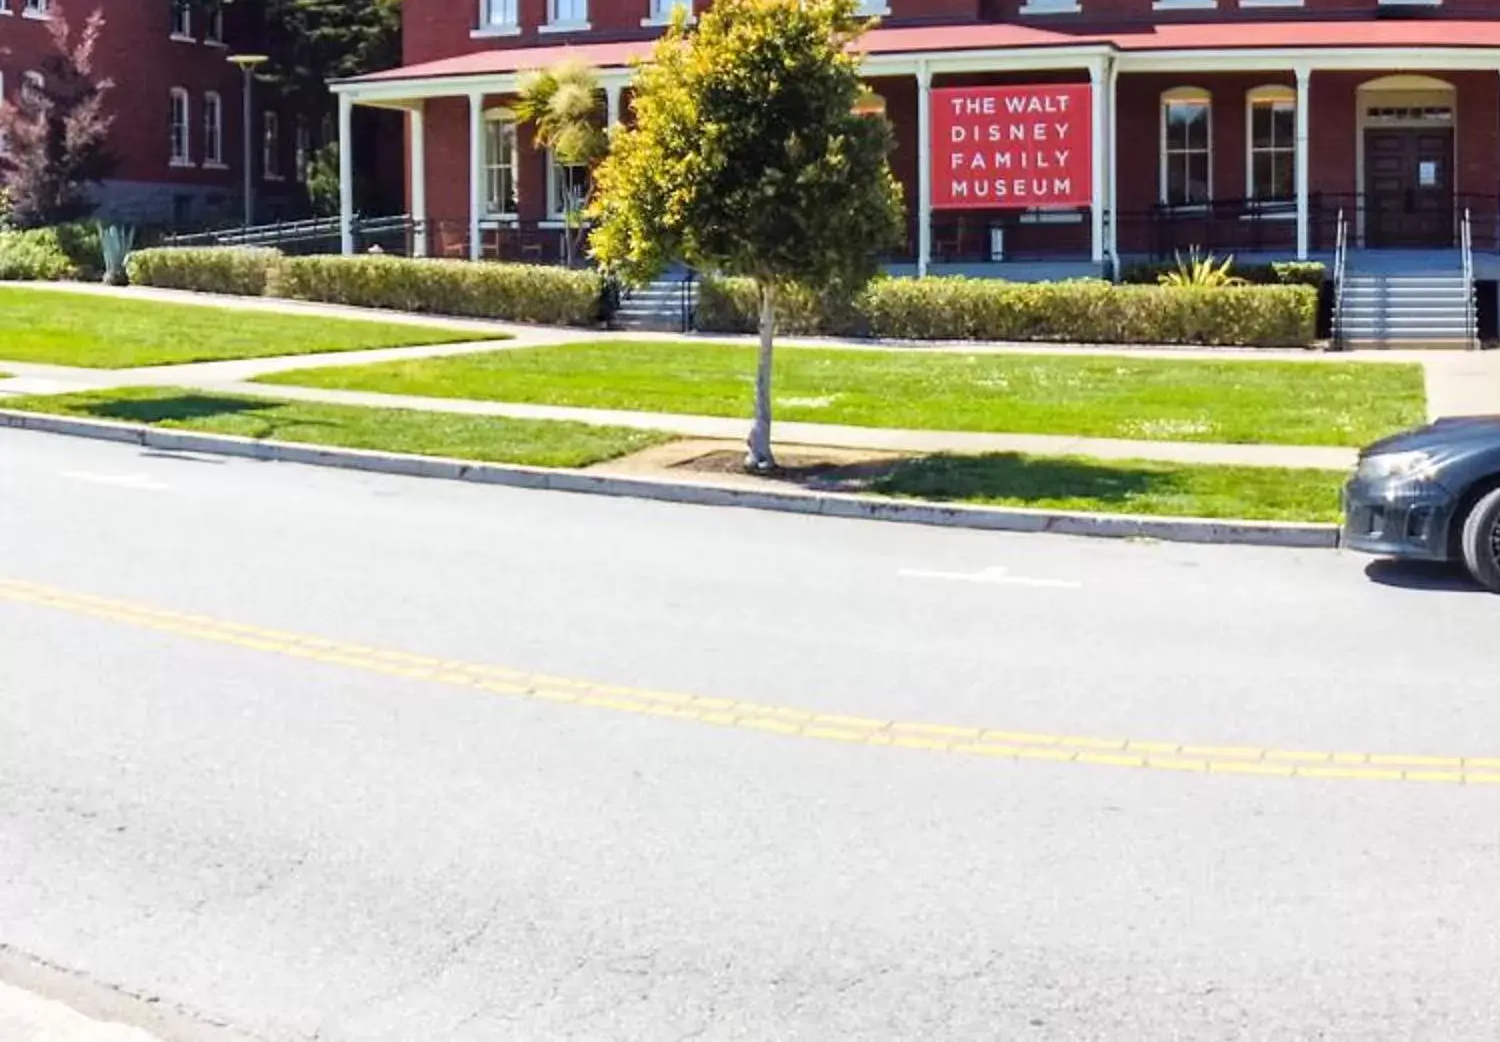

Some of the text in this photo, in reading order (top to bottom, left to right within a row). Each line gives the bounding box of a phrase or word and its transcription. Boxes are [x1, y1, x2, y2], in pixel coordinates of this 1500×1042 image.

[952, 96, 1068, 114] THE WALT
[951, 124, 1069, 142] DISNEY
[951, 151, 1069, 169] FAMILY
[951, 178, 1070, 196] MUSEUM
